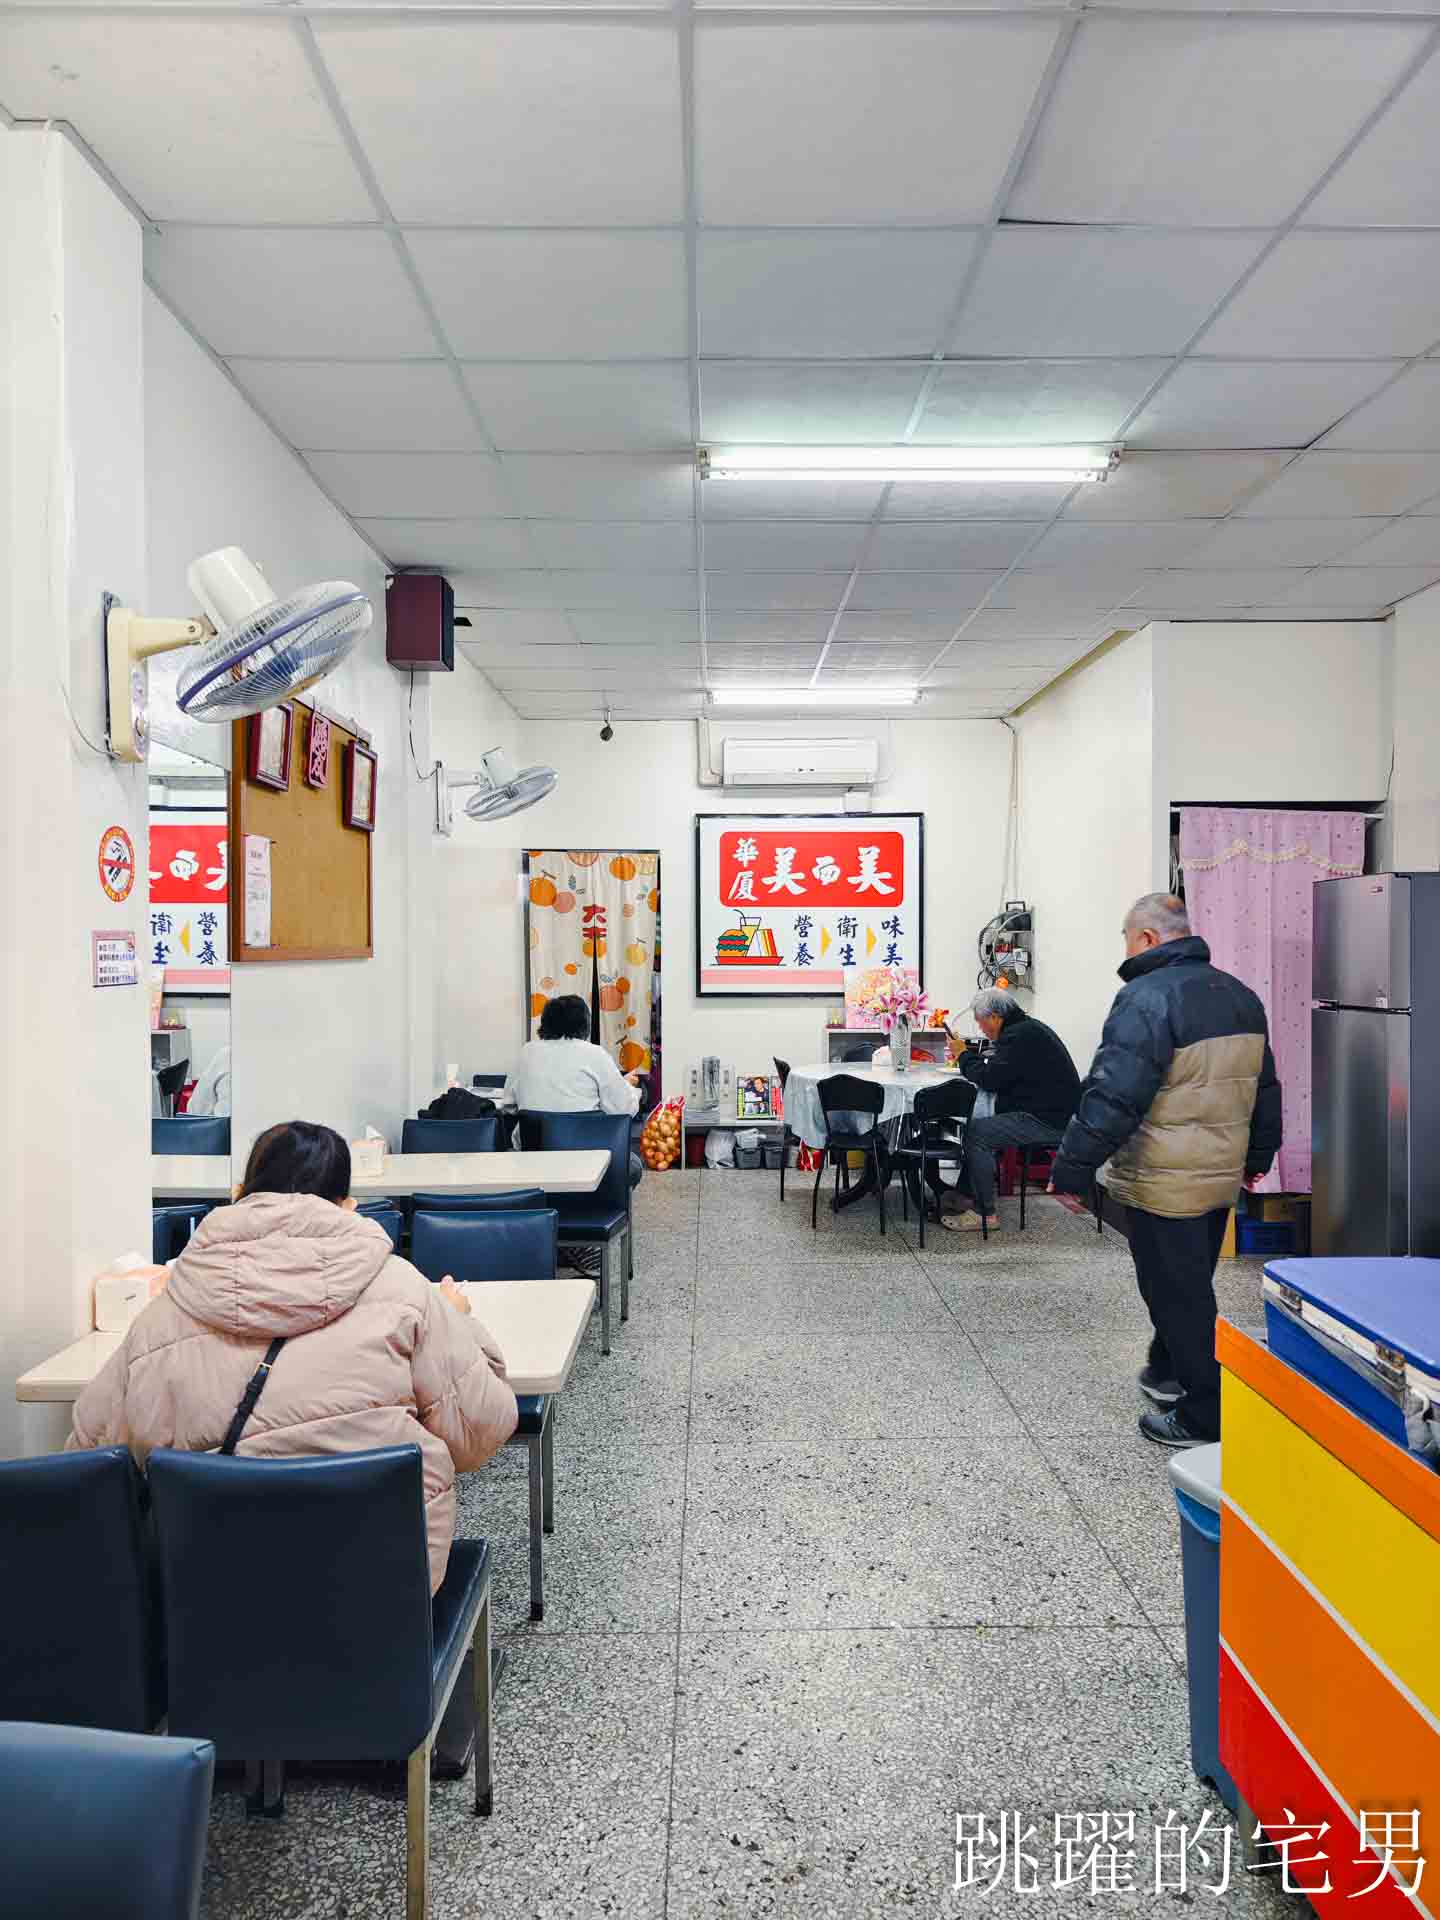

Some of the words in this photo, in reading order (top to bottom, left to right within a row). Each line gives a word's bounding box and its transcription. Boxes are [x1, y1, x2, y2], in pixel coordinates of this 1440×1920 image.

[761, 846, 897, 896] 美而美
[793, 914, 815, 966] 營養
[881, 914, 905, 967] 味美
